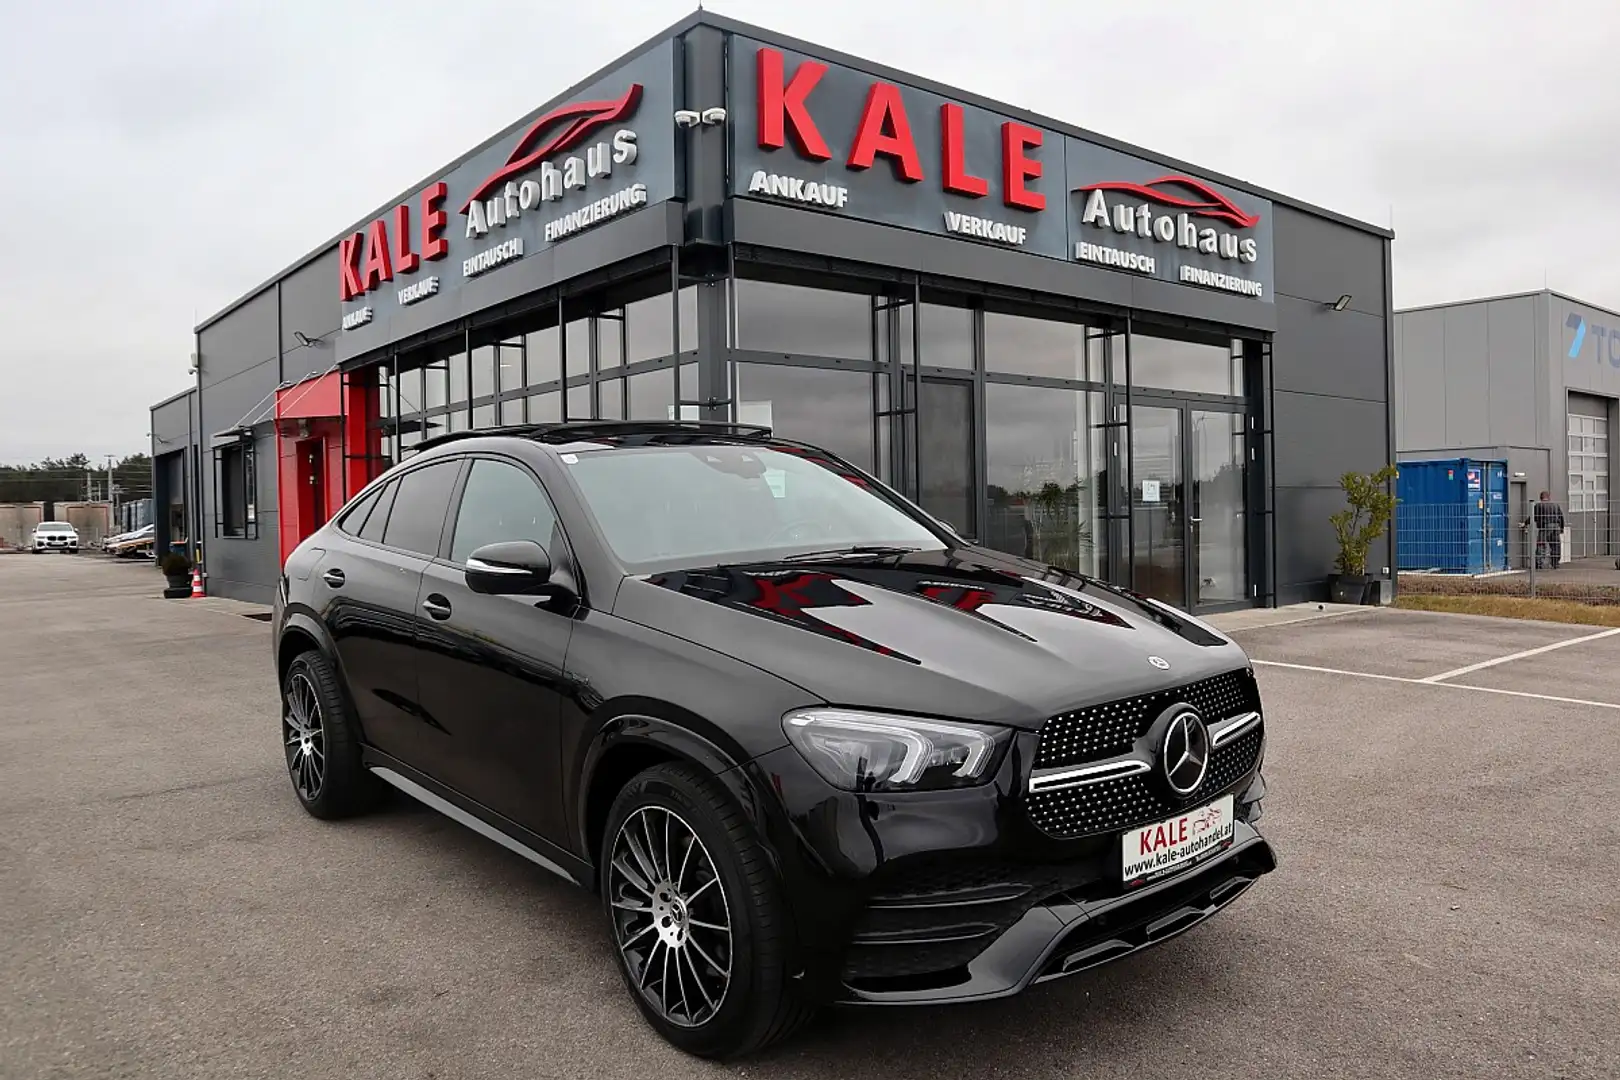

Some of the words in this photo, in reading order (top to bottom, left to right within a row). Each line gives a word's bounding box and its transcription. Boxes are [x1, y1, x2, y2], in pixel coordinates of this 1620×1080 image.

[756, 47, 1046, 211] KALE
[462, 238, 524, 277] EINTAUSCH
[545, 183, 647, 242] FINANZIERUNG
[465, 129, 638, 239] Autohaus
[748, 170, 848, 208] ANKAUF
[943, 211, 1026, 245] VERKAUF
[1075, 241, 1155, 274] EINTAUSCH
[1180, 265, 1262, 297] FINANZIERUNG
[1082, 189, 1257, 263] Autohaus
[339, 182, 448, 301] KALE
[1124, 822, 1232, 877] www.kale-autohandel.at
[1140, 817, 1188, 856] KALE
